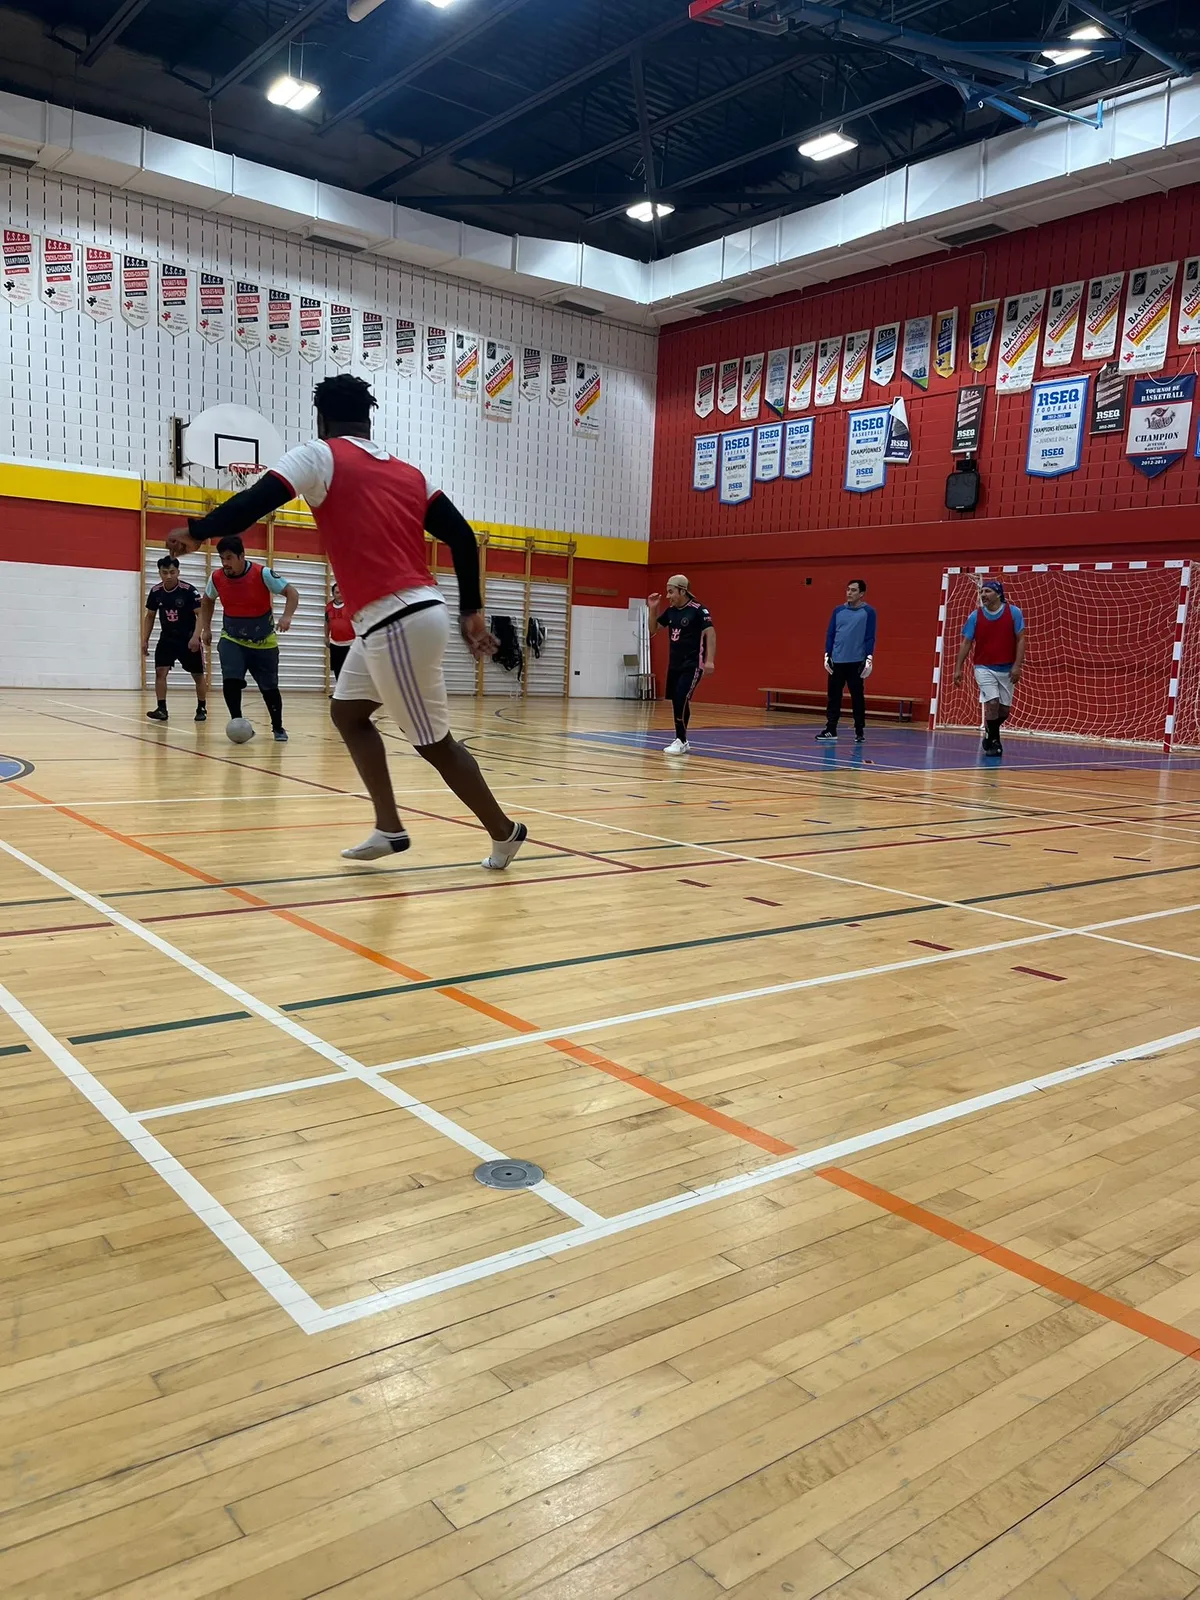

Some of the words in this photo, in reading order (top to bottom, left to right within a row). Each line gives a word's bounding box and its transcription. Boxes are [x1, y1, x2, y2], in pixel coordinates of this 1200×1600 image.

[46, 264, 71, 274] CHAMPIONS
[88, 273, 112, 283] CHAMPIONS
[1183, 281, 1200, 303] BASK
[1087, 284, 1121, 321] FOOTBALL
[1127, 275, 1174, 325] BASKETBALL
[1048, 292, 1081, 329] BASKETBALL
[1089, 296, 1120, 331] CHAMPIONS
[1128, 292, 1171, 339] CHAMPIONNES
[1002, 302, 1042, 348] BASKETBALL
[1003, 318, 1040, 361] CHAMPIONNES
[844, 340, 868, 370] FOOTBALL
[486, 364, 513, 392] CHAMPIONS
[575, 371, 600, 399] BASKETBALL
[1145, 386, 1171, 394] TOURNOI
[1037, 388, 1080, 407] RSEQ
[1141, 391, 1185, 402] BASKETBALL
[1036, 403, 1078, 413] FOOTBALL
[1095, 409, 1121, 421] RSEQ
[788, 424, 810, 436] RSEQ
[852, 416, 885, 432] RSEQ
[1033, 425, 1056, 434] CHAMPIONS
[759, 429, 780, 440] RSEQ
[956, 428, 976, 438] RSEQ
[1134, 431, 1180, 443] CHAMPION
[697, 440, 716, 451] RSEQ
[724, 436, 751, 451] RSEQ
[890, 439, 909, 447] RSEQ
[850, 446, 882, 456] CHAMPIONNES
[1041, 447, 1065, 457] RSEQ
[725, 463, 747, 472] CHAMPIONS
[856, 467, 874, 476] RSEQ
